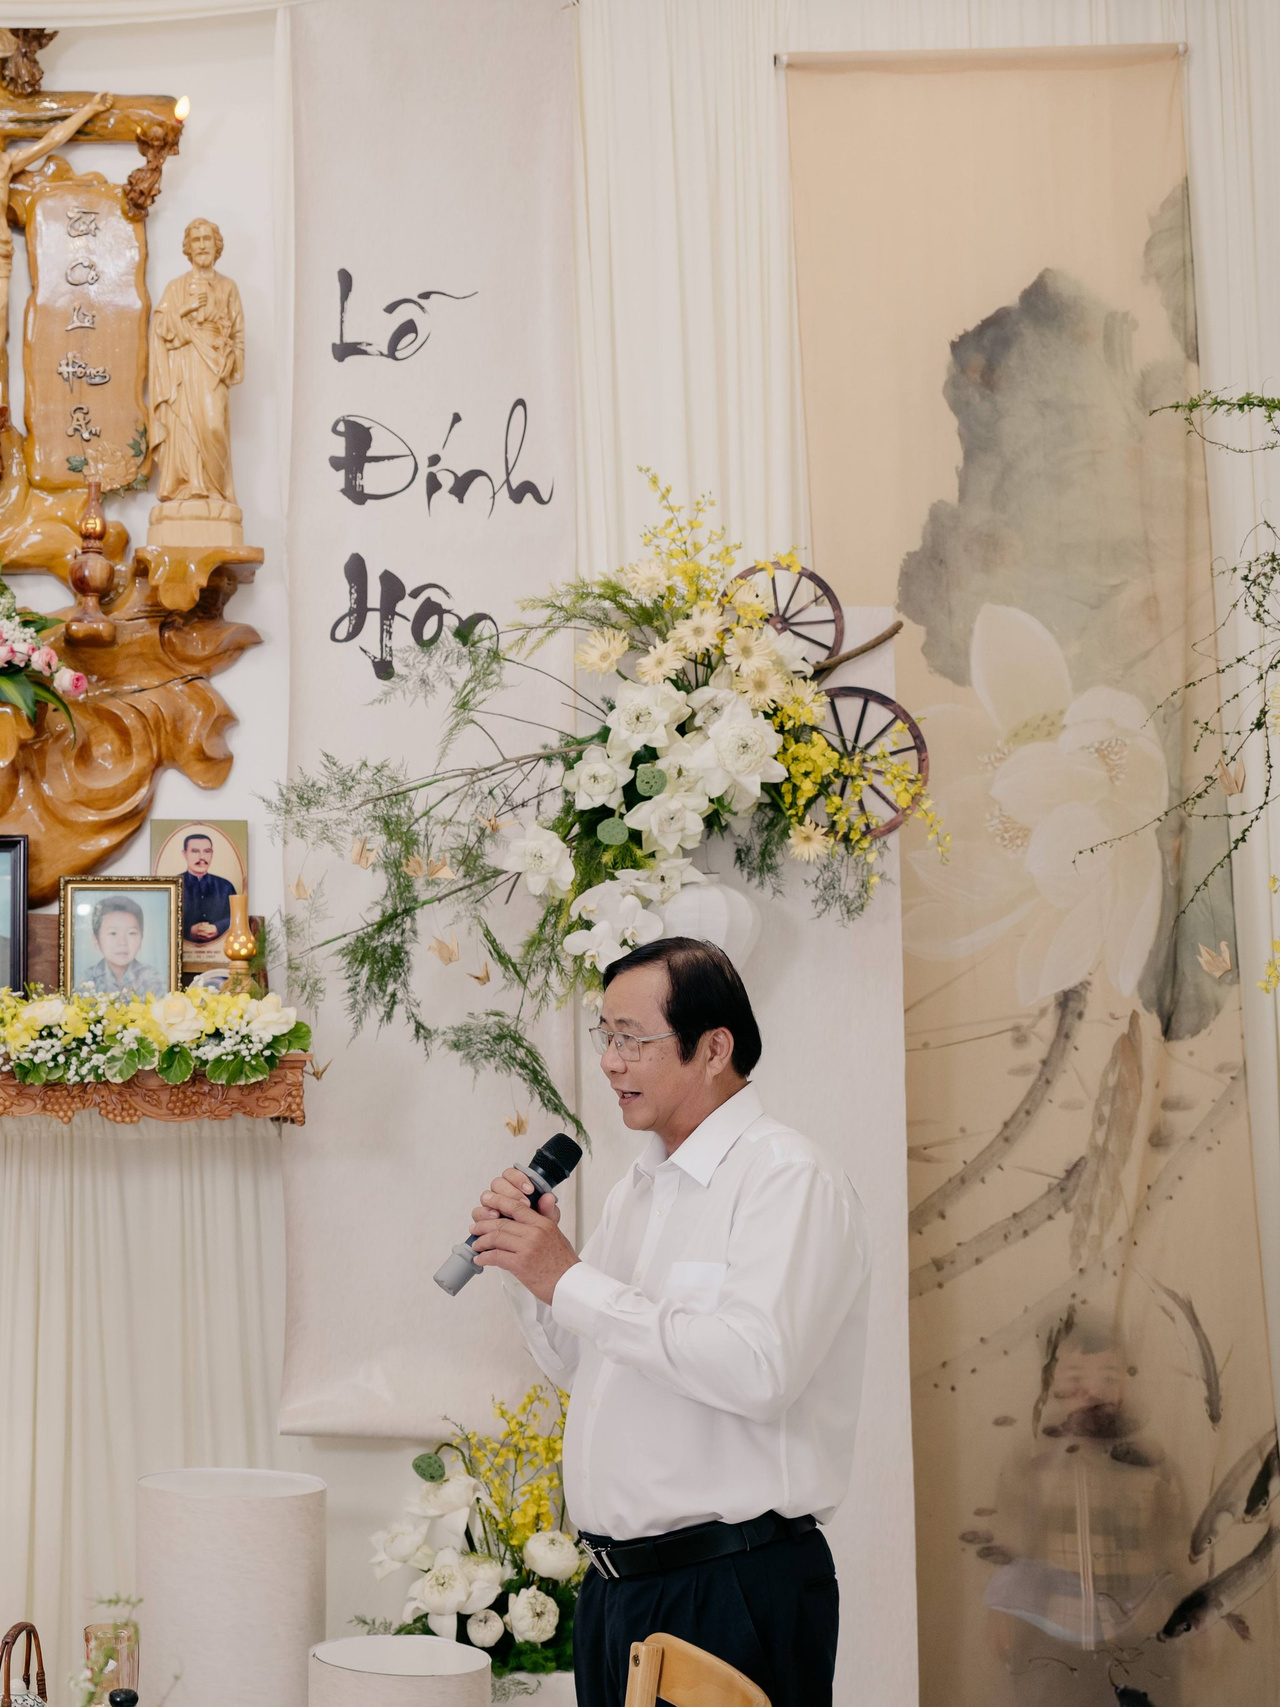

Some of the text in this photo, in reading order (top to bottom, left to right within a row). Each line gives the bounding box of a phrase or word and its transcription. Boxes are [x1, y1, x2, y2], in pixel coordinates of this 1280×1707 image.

[331, 267, 479, 363] Lễ
[328, 397, 555, 520] Đính
[329, 551, 500, 681] Hôn
